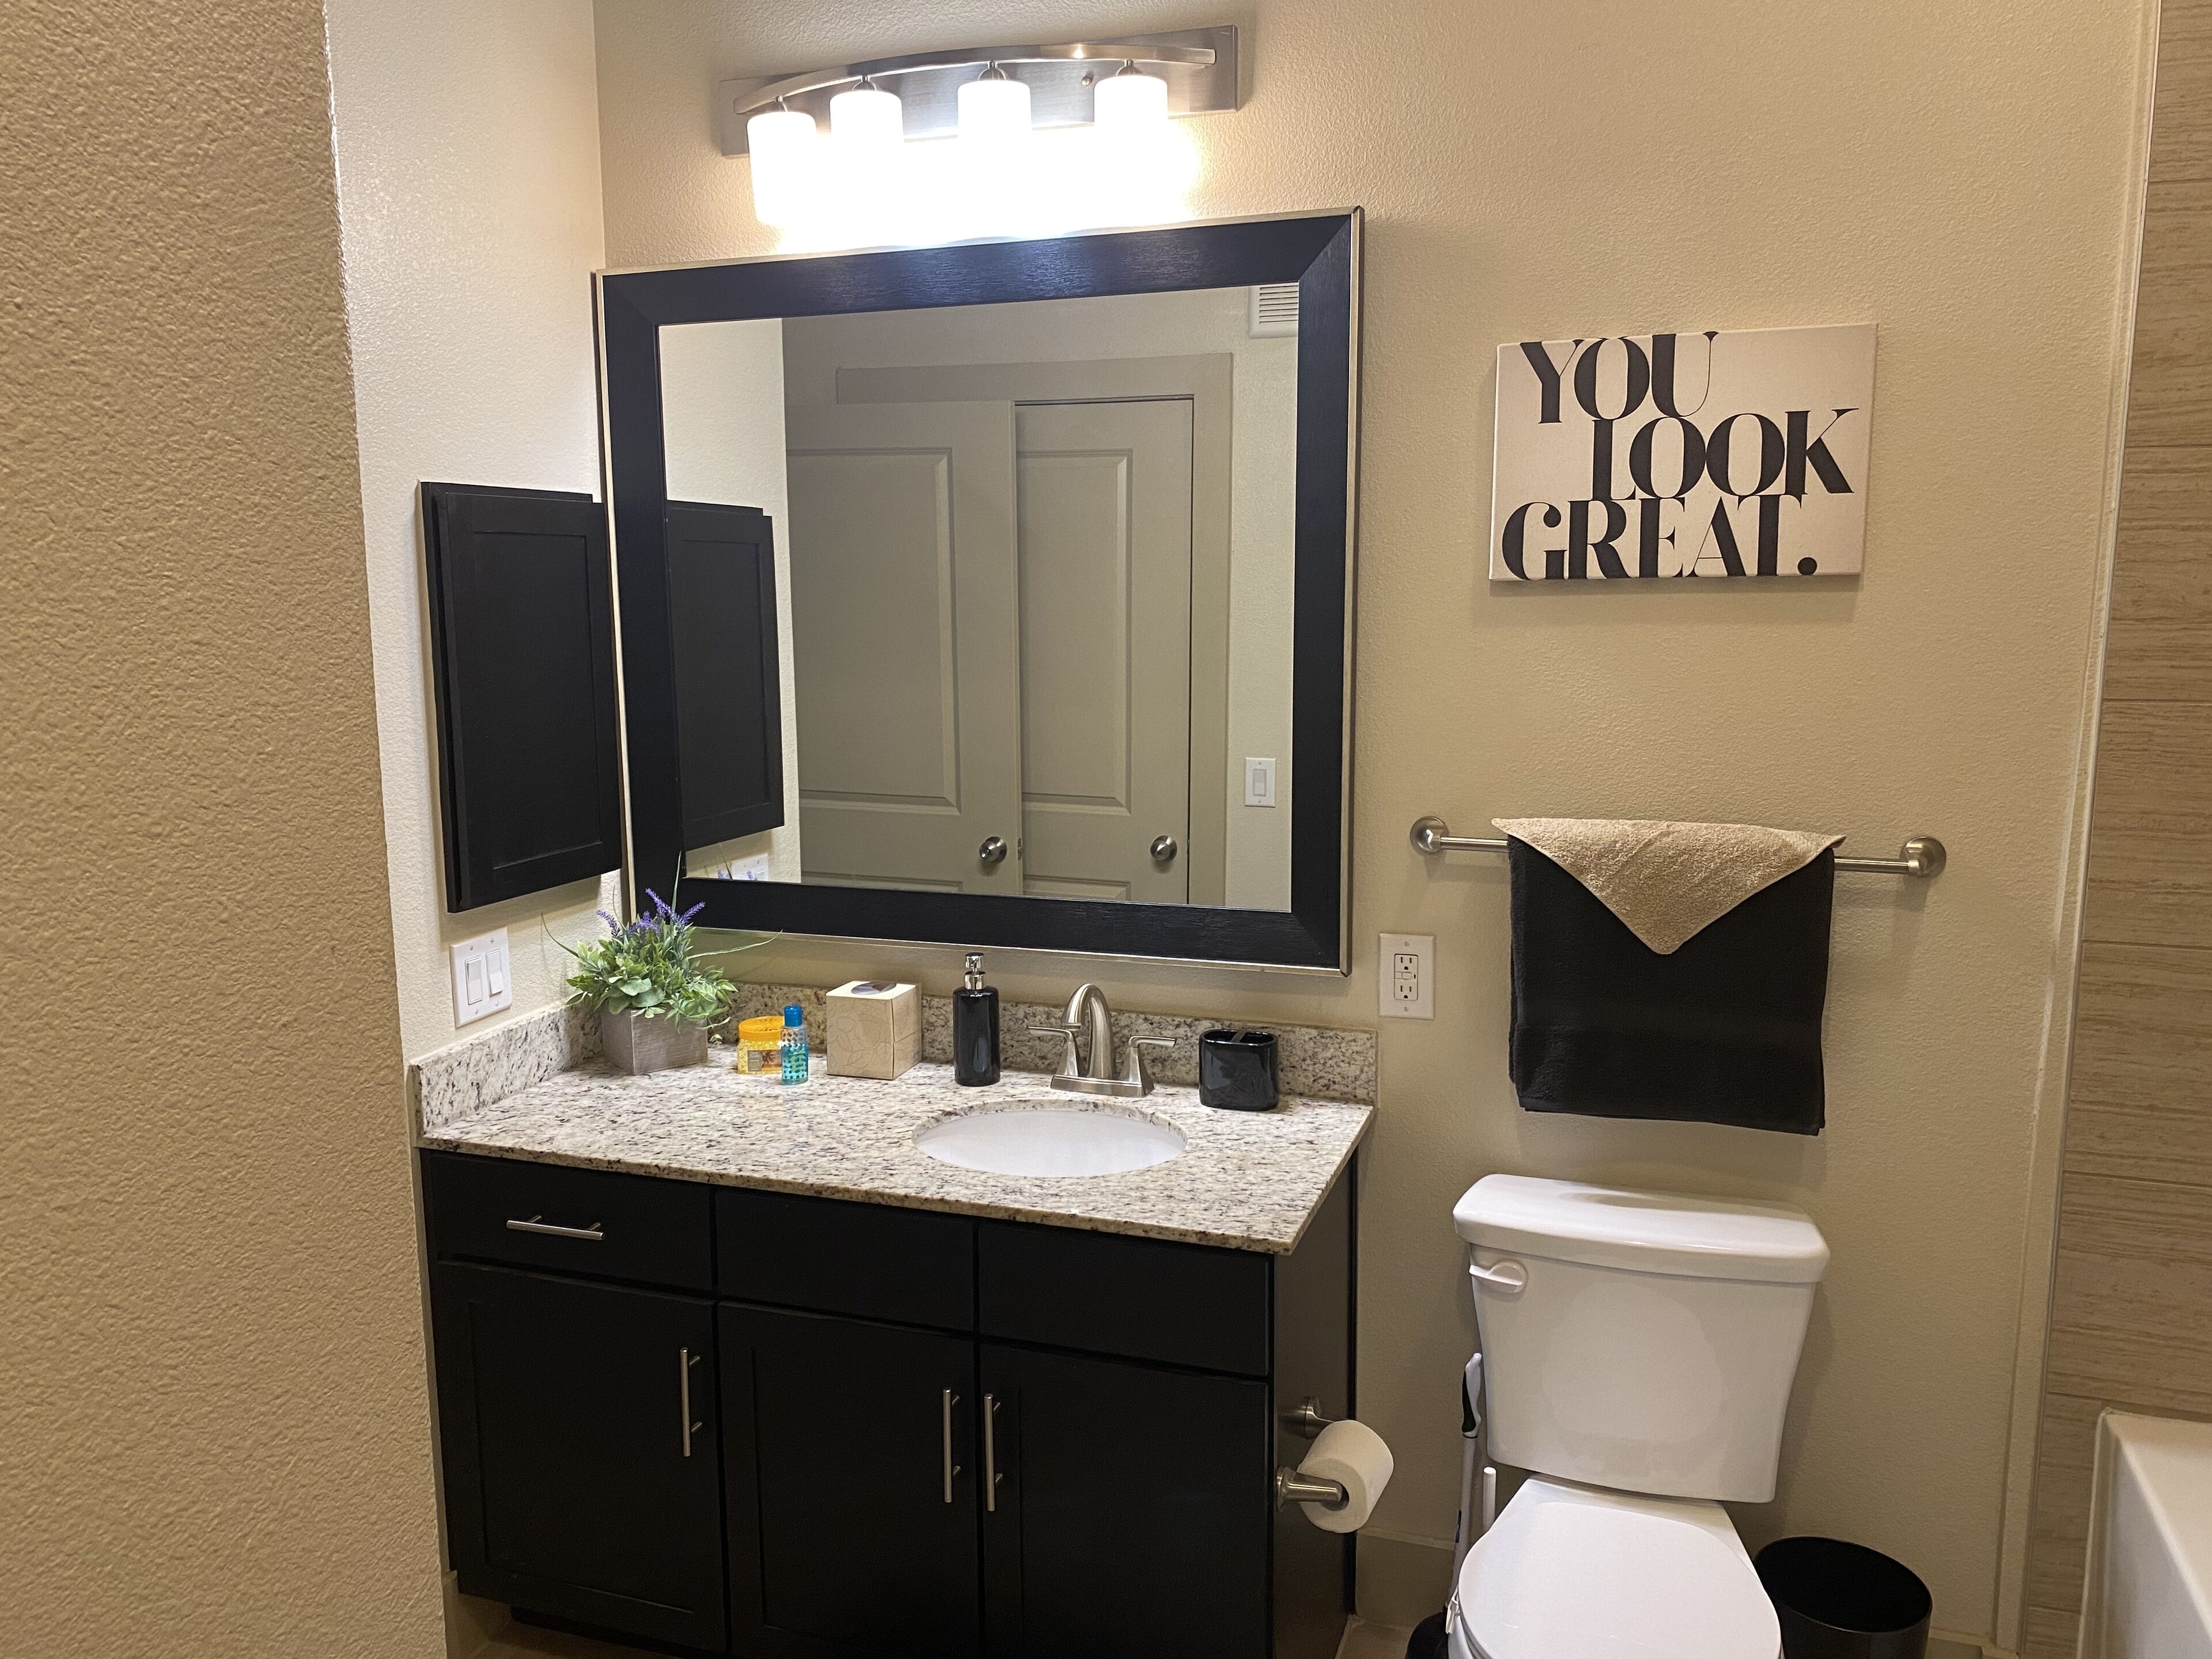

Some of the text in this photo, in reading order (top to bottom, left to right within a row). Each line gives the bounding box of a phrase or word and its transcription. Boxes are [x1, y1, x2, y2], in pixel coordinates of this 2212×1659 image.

[1520, 331, 1719, 423] YOU
[1592, 408, 1859, 500] LOOK
[1502, 494, 1817, 579] GREAT.
